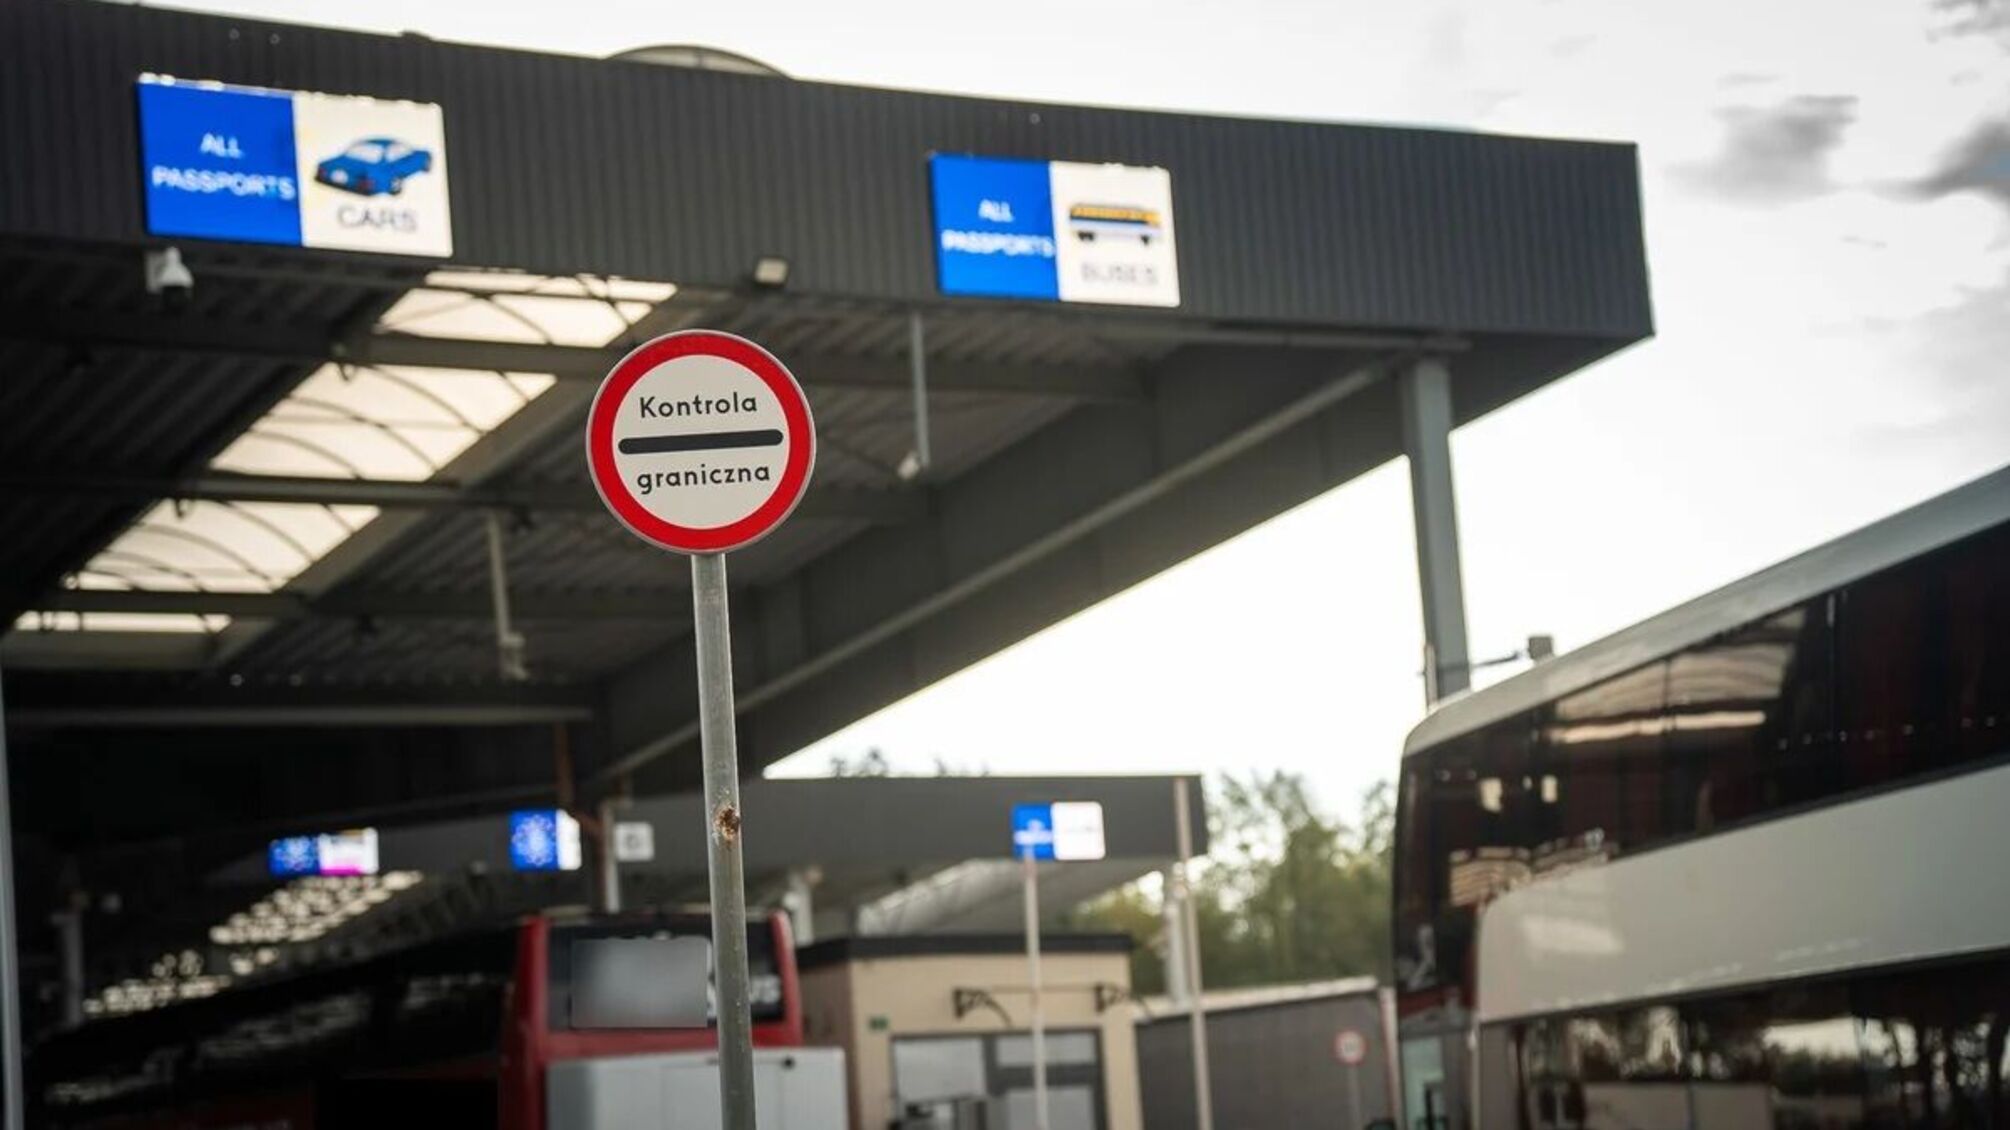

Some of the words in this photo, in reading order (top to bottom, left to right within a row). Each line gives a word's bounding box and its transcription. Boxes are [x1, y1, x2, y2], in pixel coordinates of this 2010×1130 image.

[201, 132, 242, 159] ALL
[151, 166, 296, 200] PASSPORTS
[336, 205, 417, 232] CARS
[639, 391, 757, 418] Kontrola
[637, 463, 770, 495] graniczna
